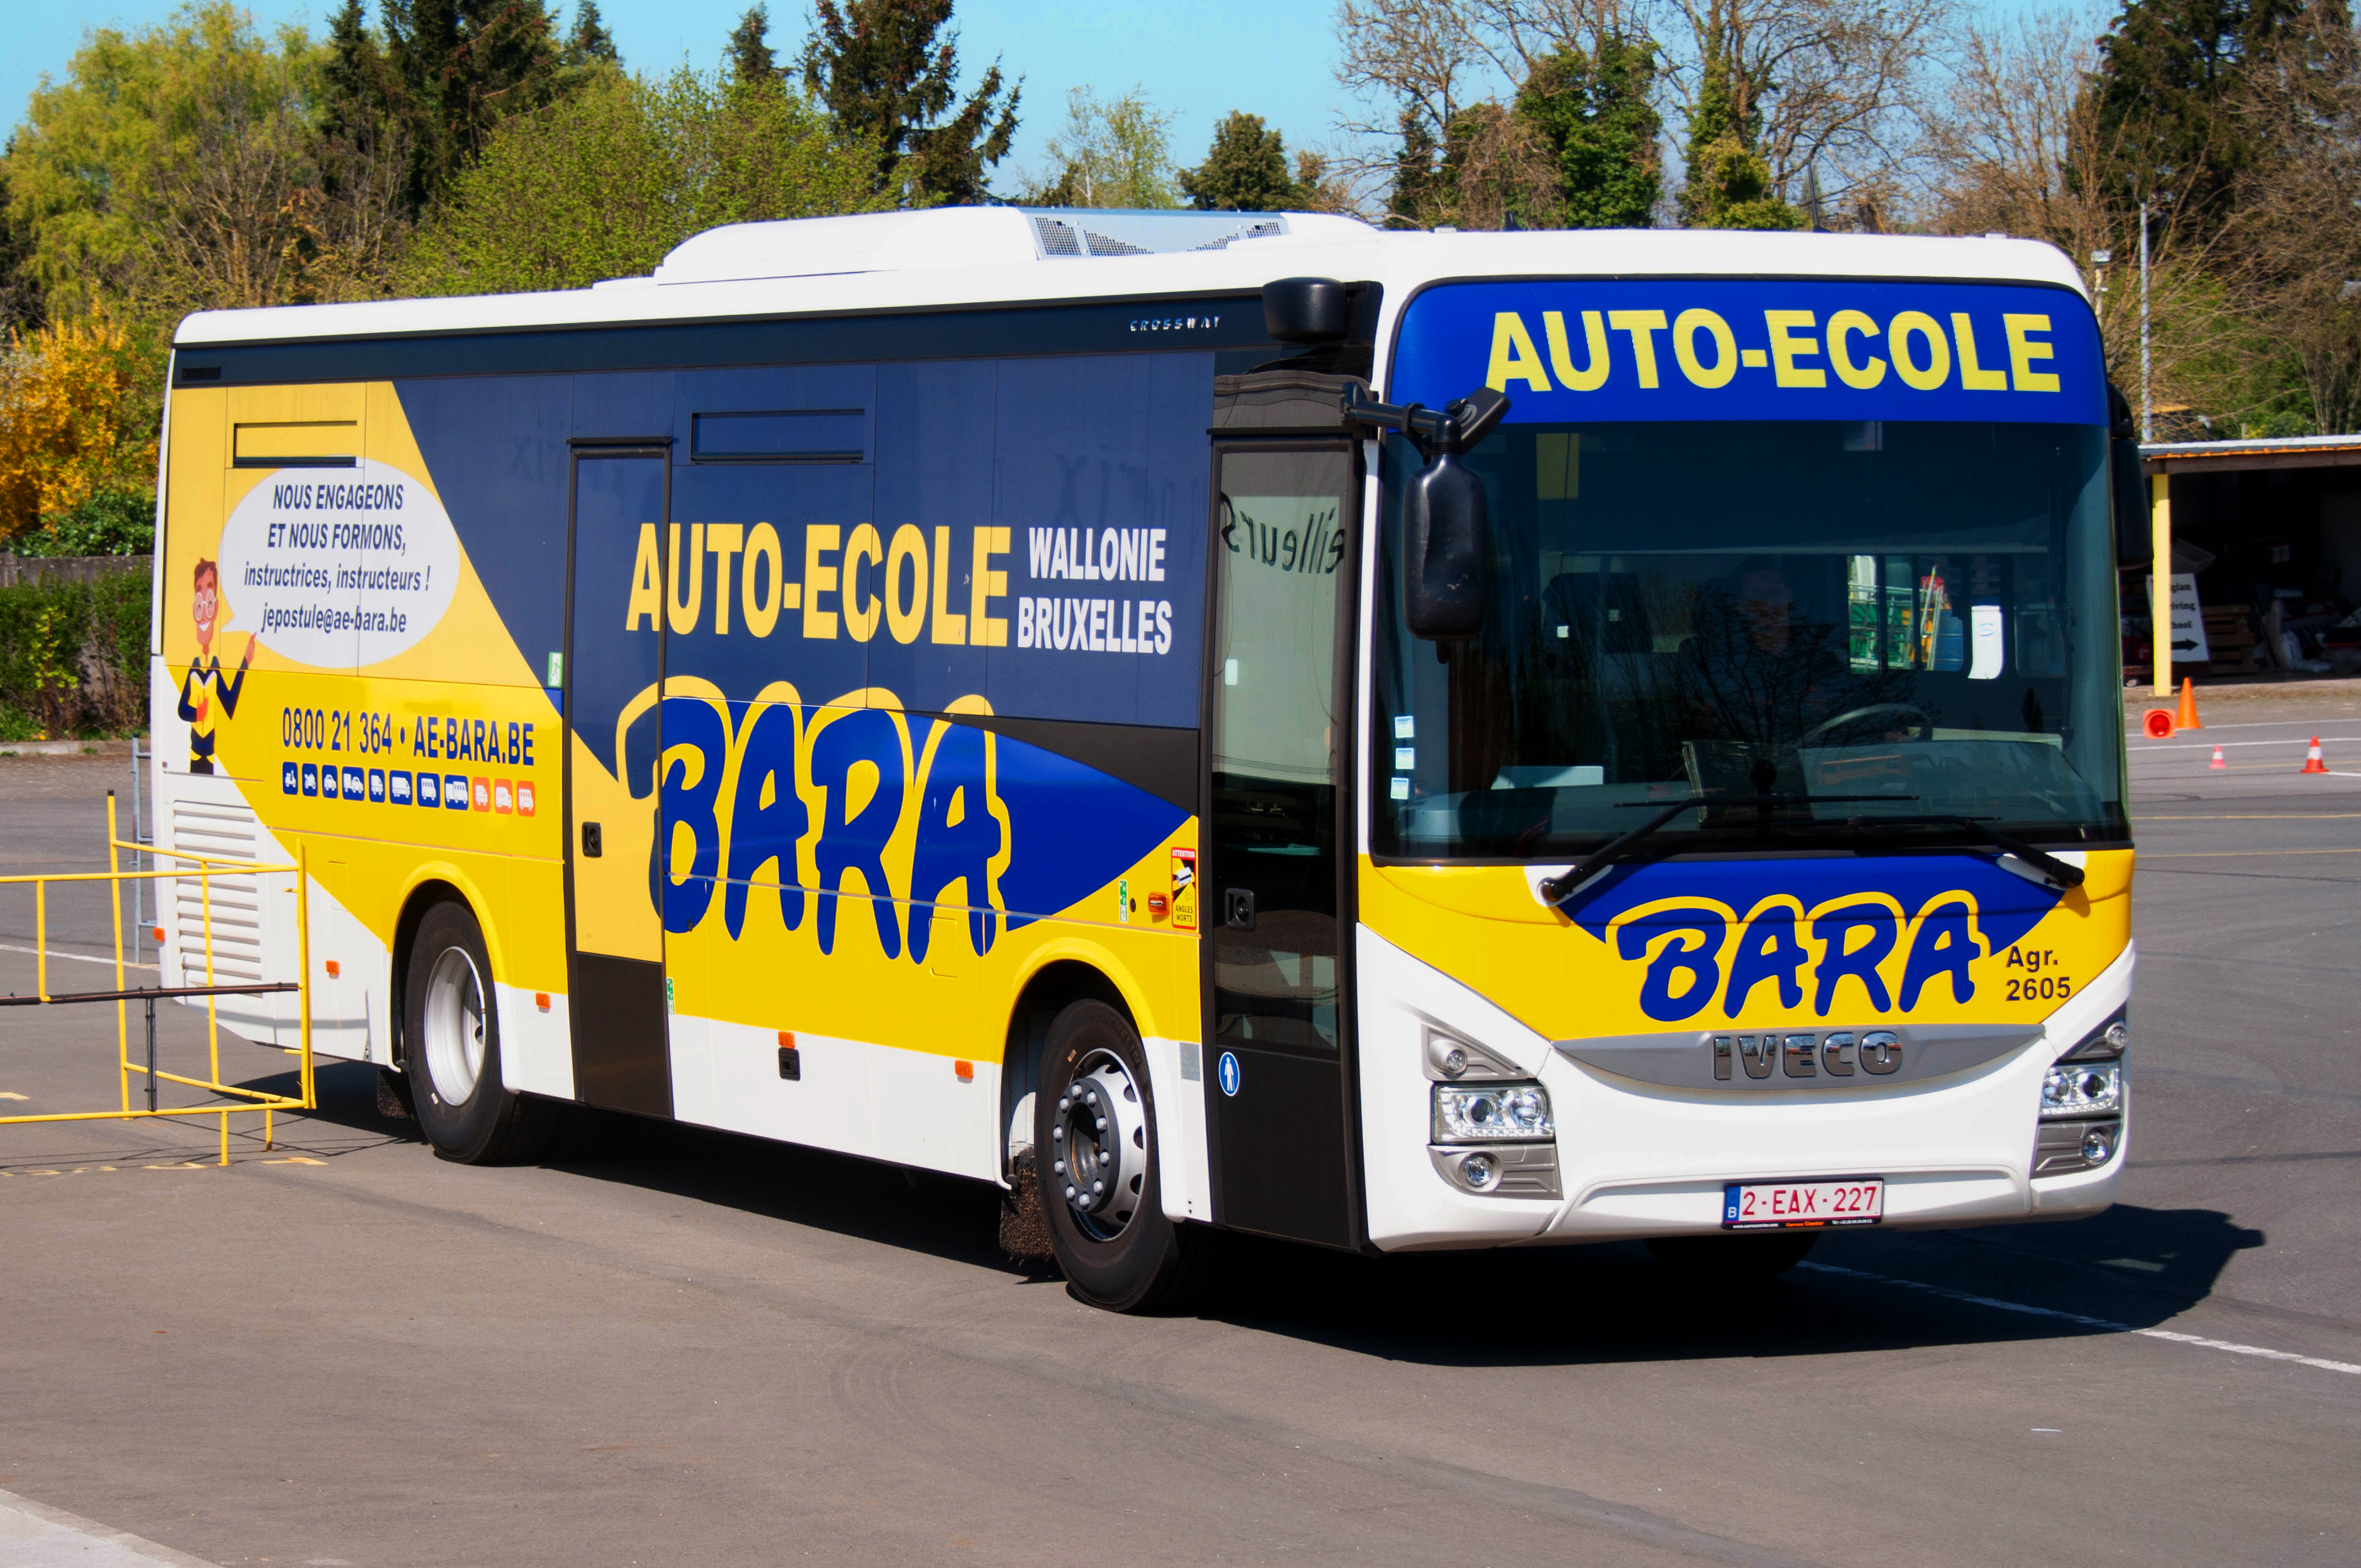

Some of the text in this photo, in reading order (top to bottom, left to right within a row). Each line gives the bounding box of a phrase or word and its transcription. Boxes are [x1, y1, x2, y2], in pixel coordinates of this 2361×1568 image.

[1130, 316, 1220, 331] CROSSWAY
[1484, 308, 2061, 393] AUTO-ECOLE
[273, 484, 404, 510] NOUS ENGAGEONS
[268, 523, 406, 557] ET NOUS FORMONS,
[1028, 527, 1167, 582] WALLONIE
[244, 561, 431, 595] instructrices, instructeurs !
[625, 521, 1011, 647] AUTO-ECOLE
[261, 602, 407, 634] jepostule@ae-bara.be
[1017, 597, 1172, 655] BRUXELLES
[282, 707, 535, 766] 0800 21 364 AE-BARA.BE
[616, 676, 1012, 965] BARA
[1172, 850, 1195, 858] ATTENTION
[1176, 905, 1193, 913] ANGLES
[1176, 914, 1193, 923] MORTS
[1606, 890, 1990, 1022] BARA
[2006, 945, 2058, 973] Agr.
[2006, 976, 2070, 1001] 2605
[1713, 1030, 1903, 1081] IVECO
[1728, 1207, 1737, 1218] B
